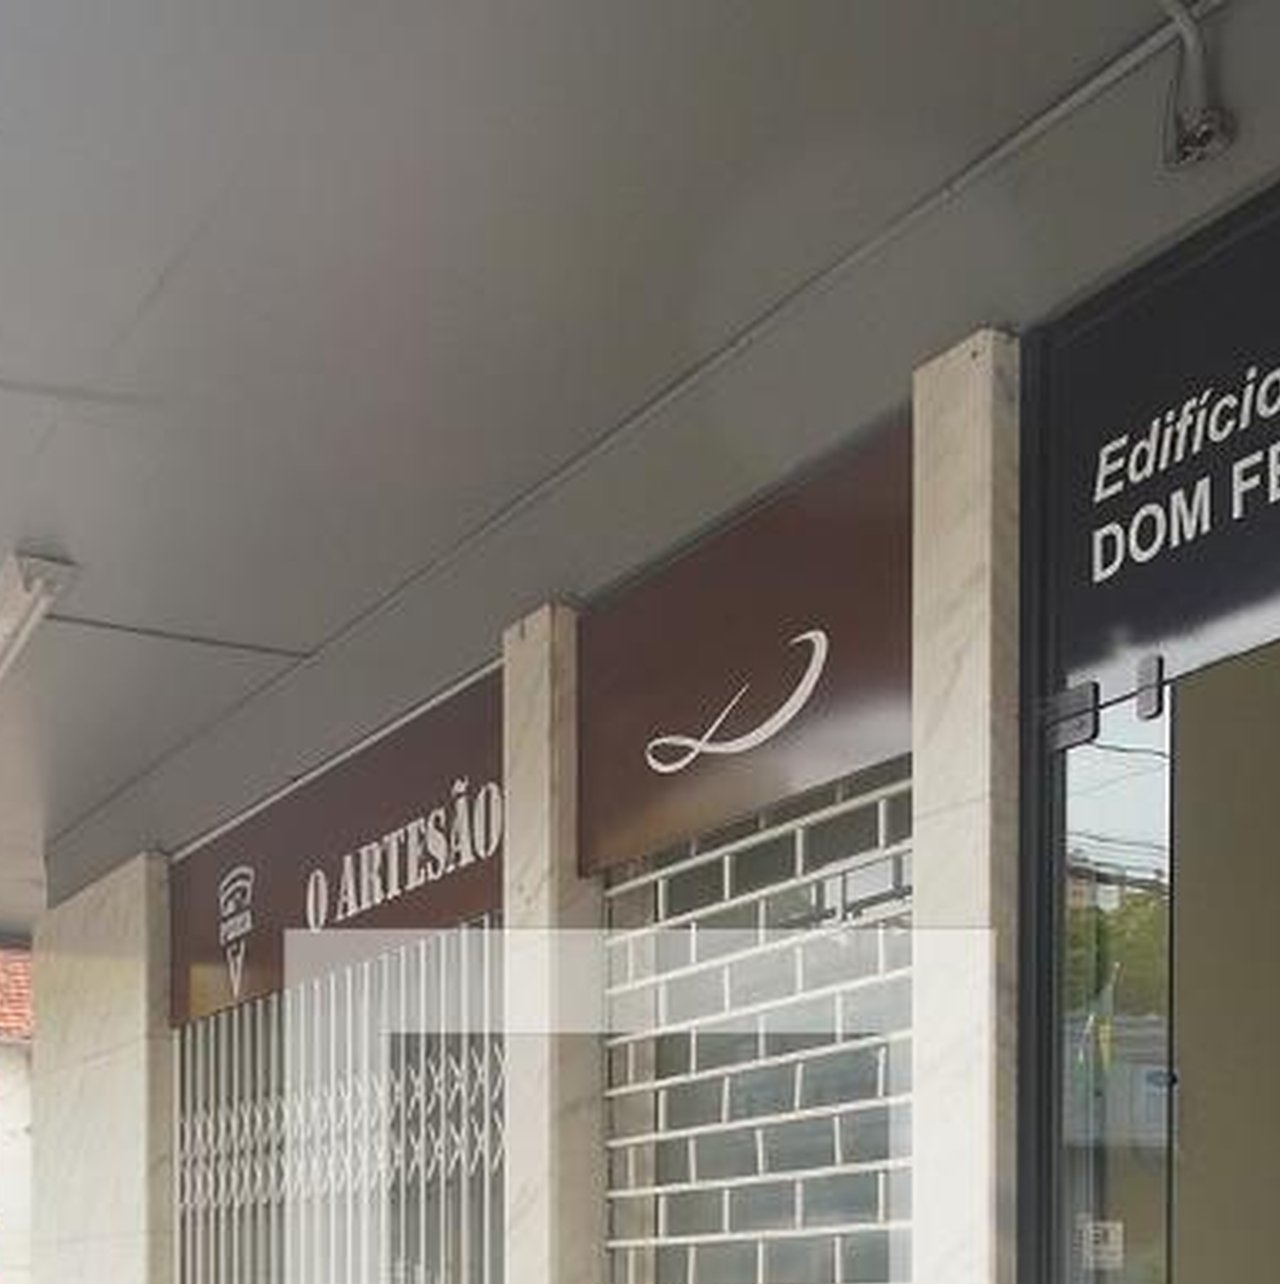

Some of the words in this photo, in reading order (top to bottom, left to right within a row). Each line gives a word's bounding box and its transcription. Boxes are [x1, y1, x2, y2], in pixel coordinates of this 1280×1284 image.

[1092, 477, 1213, 583] DOM
[306, 868, 329, 934] O
[335, 776, 505, 922] ARTESÃO
